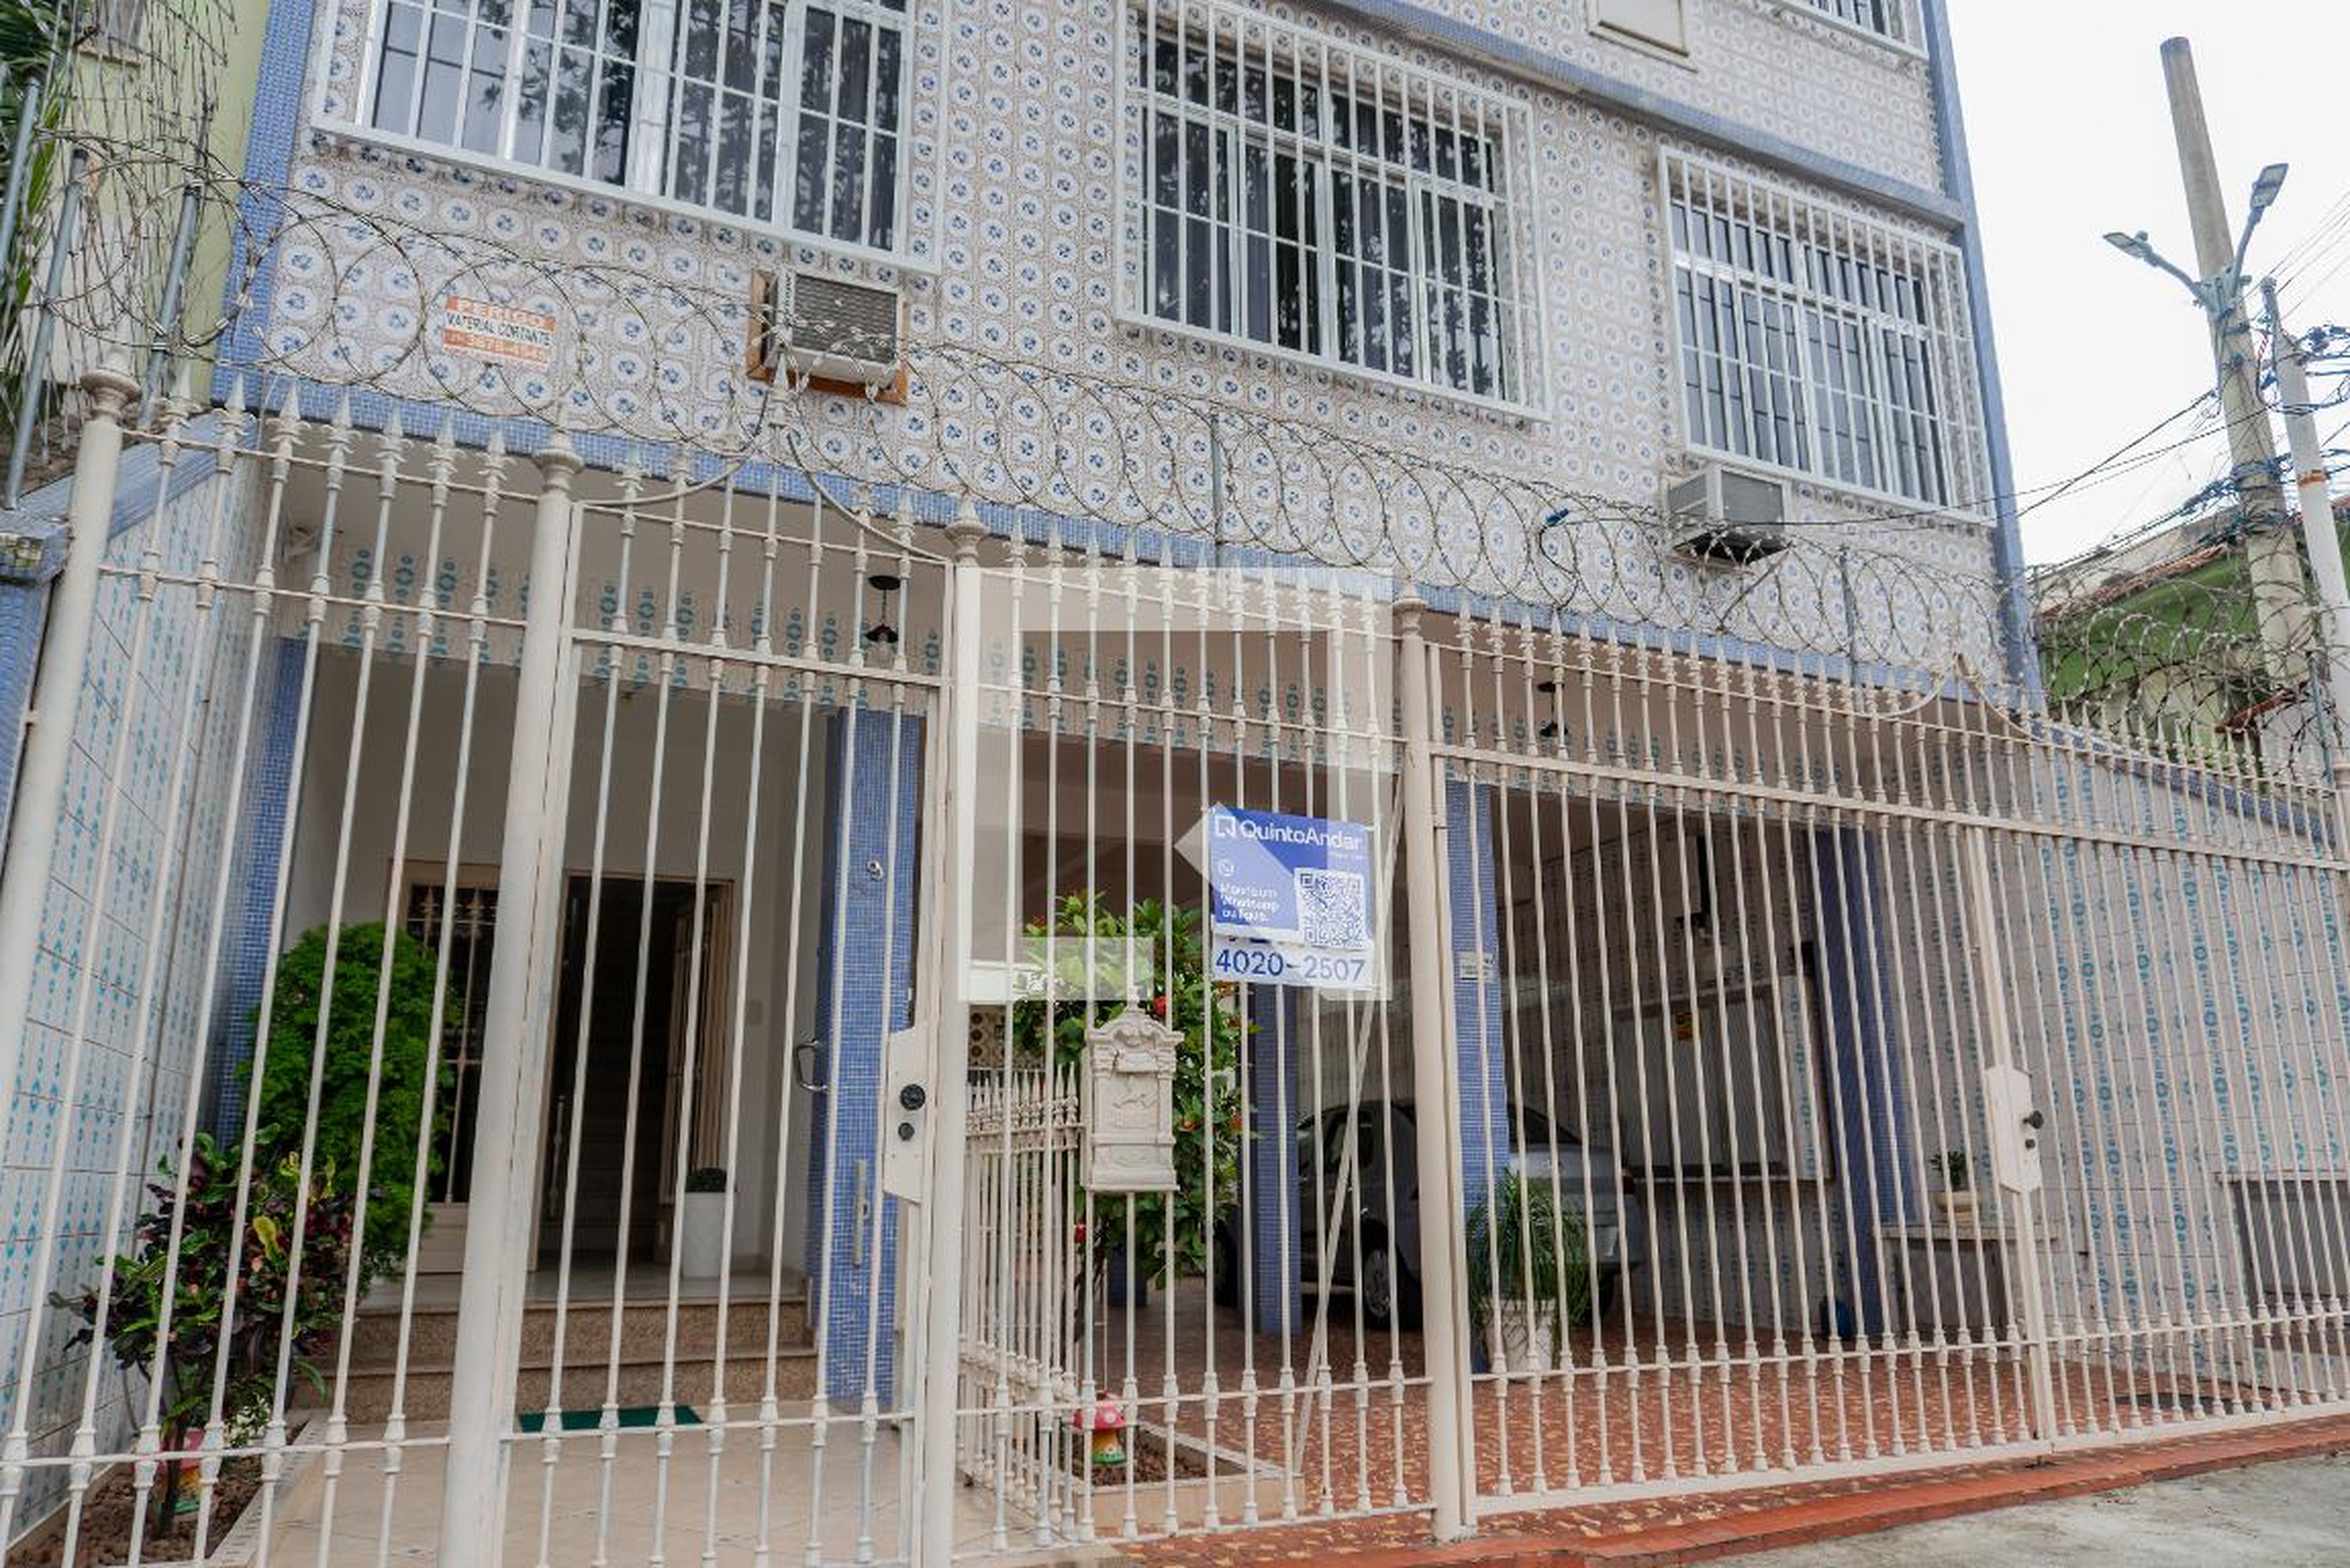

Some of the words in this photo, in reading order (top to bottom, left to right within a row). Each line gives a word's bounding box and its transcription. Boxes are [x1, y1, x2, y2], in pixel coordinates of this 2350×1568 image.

[446, 312, 494, 334] MATERIAL
[458, 299, 542, 327] PERIGO
[1240, 821, 1360, 849] QuintoAndar
